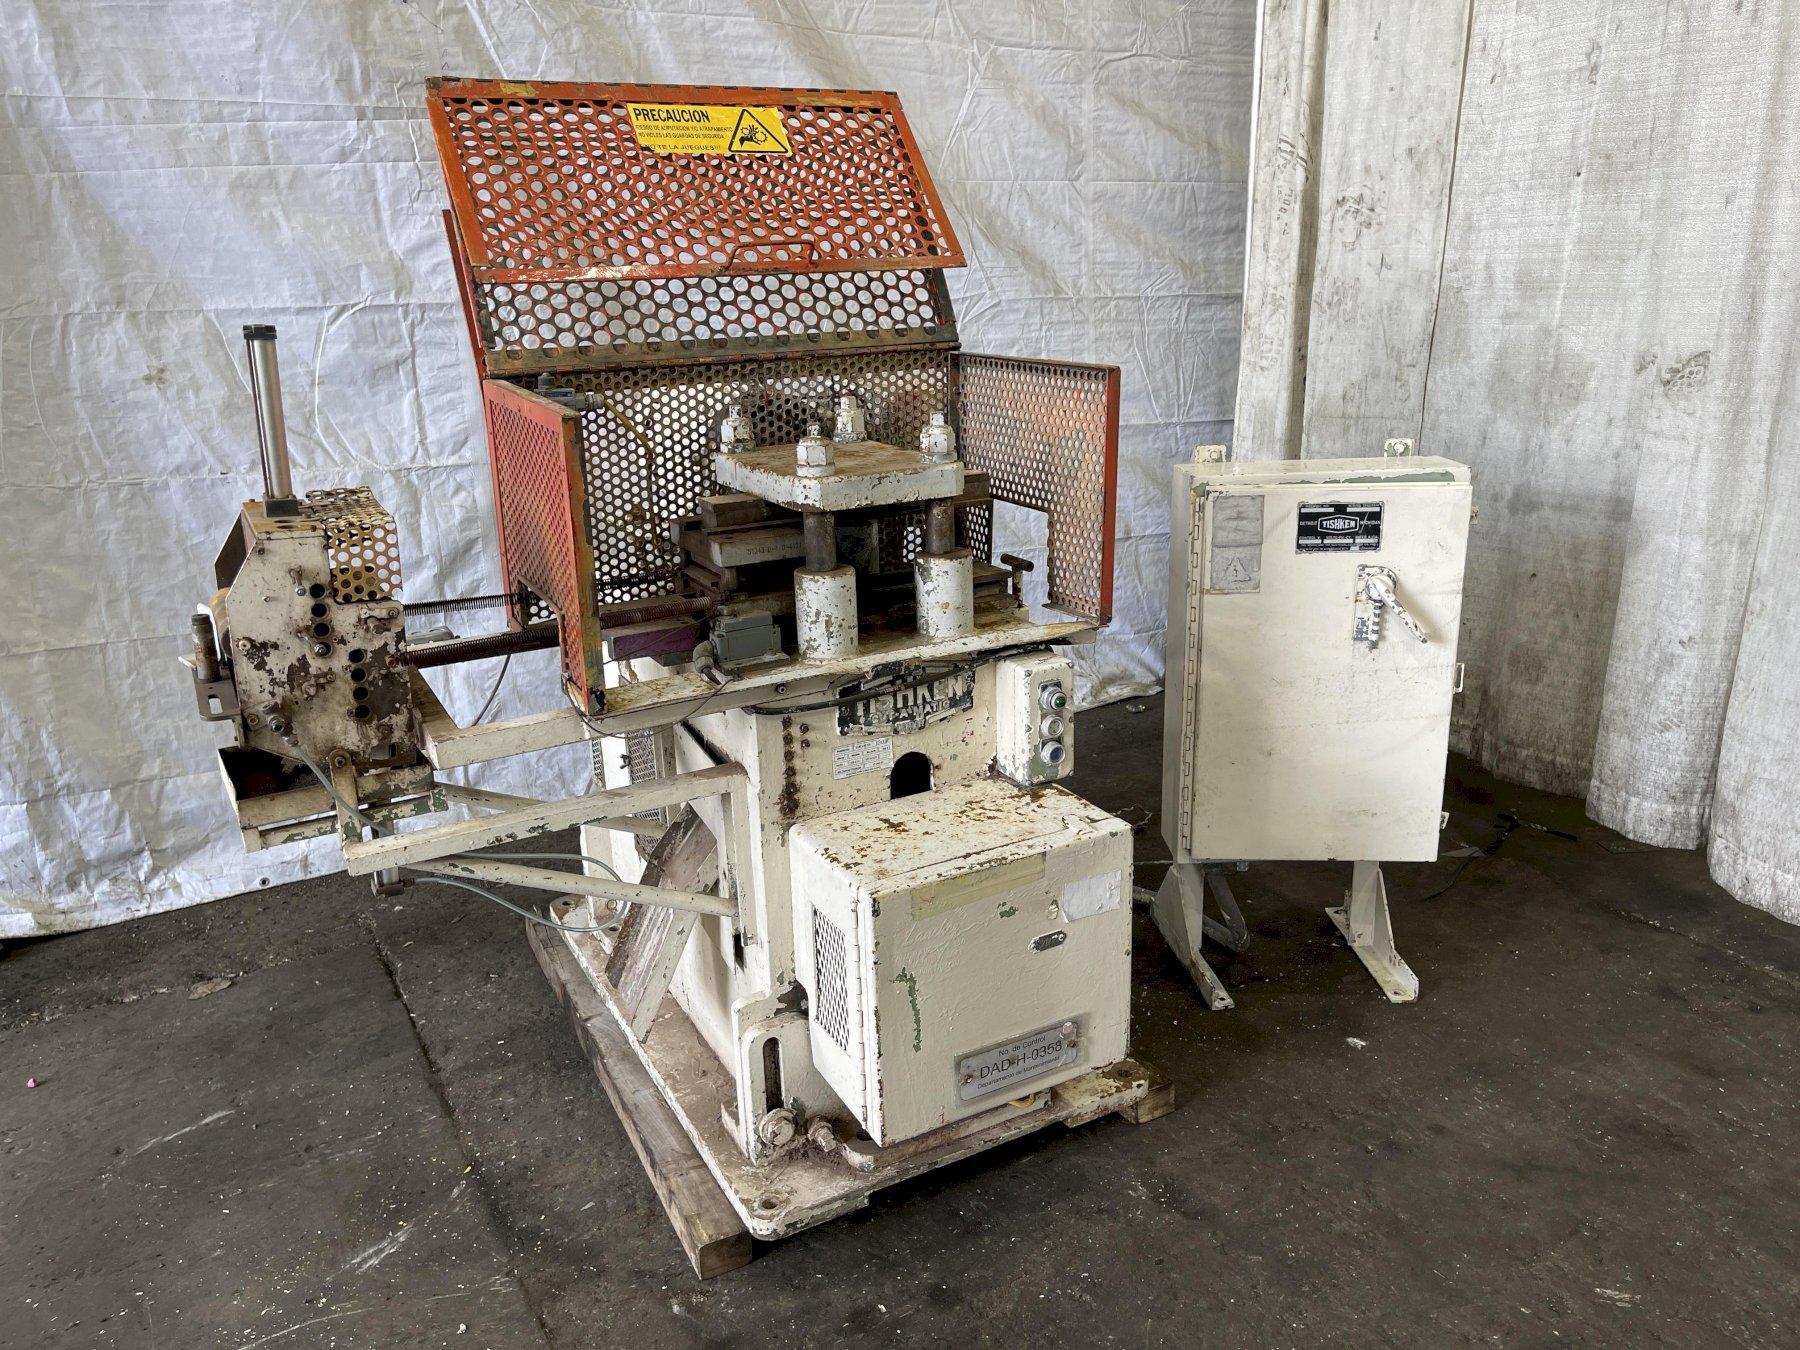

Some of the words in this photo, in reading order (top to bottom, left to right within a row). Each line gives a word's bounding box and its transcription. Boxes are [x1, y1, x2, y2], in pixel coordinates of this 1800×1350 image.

[633, 107, 710, 123] PRECAUCION
[1322, 518, 1356, 530] TISHKEN
[1023, 1036, 1046, 1049] Control
